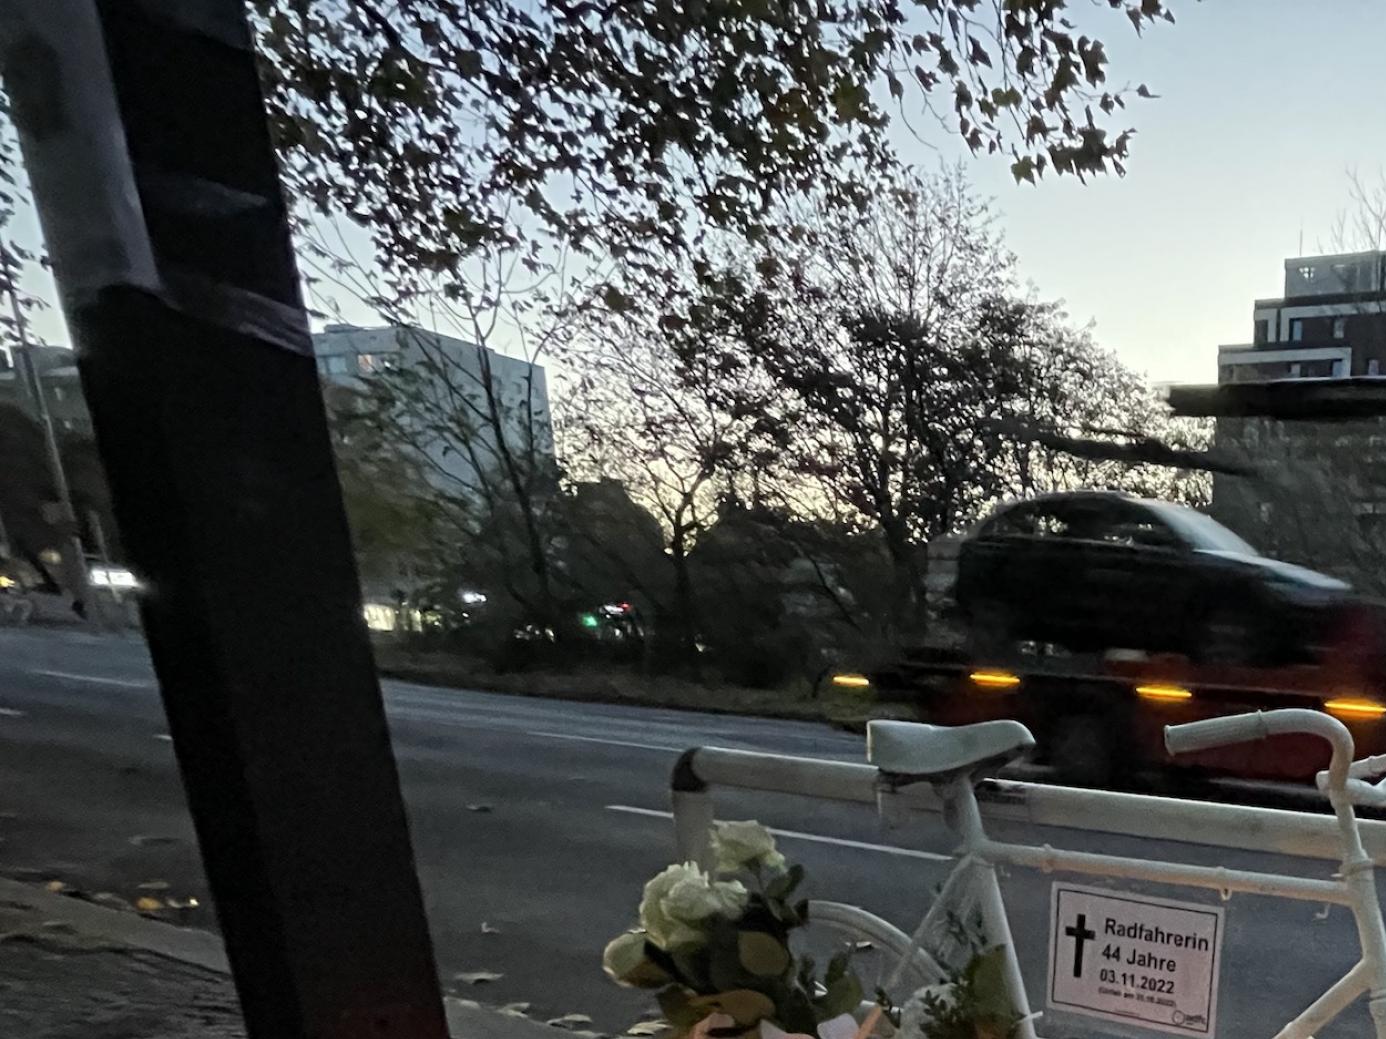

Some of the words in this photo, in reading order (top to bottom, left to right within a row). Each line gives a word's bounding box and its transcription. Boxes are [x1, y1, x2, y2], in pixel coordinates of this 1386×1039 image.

[1104, 917, 1209, 951] Radfahrerin
[1102, 943, 1121, 962] 44
[1126, 948, 1177, 972] Jahre
[1099, 969, 1175, 994] 03.11.2022
